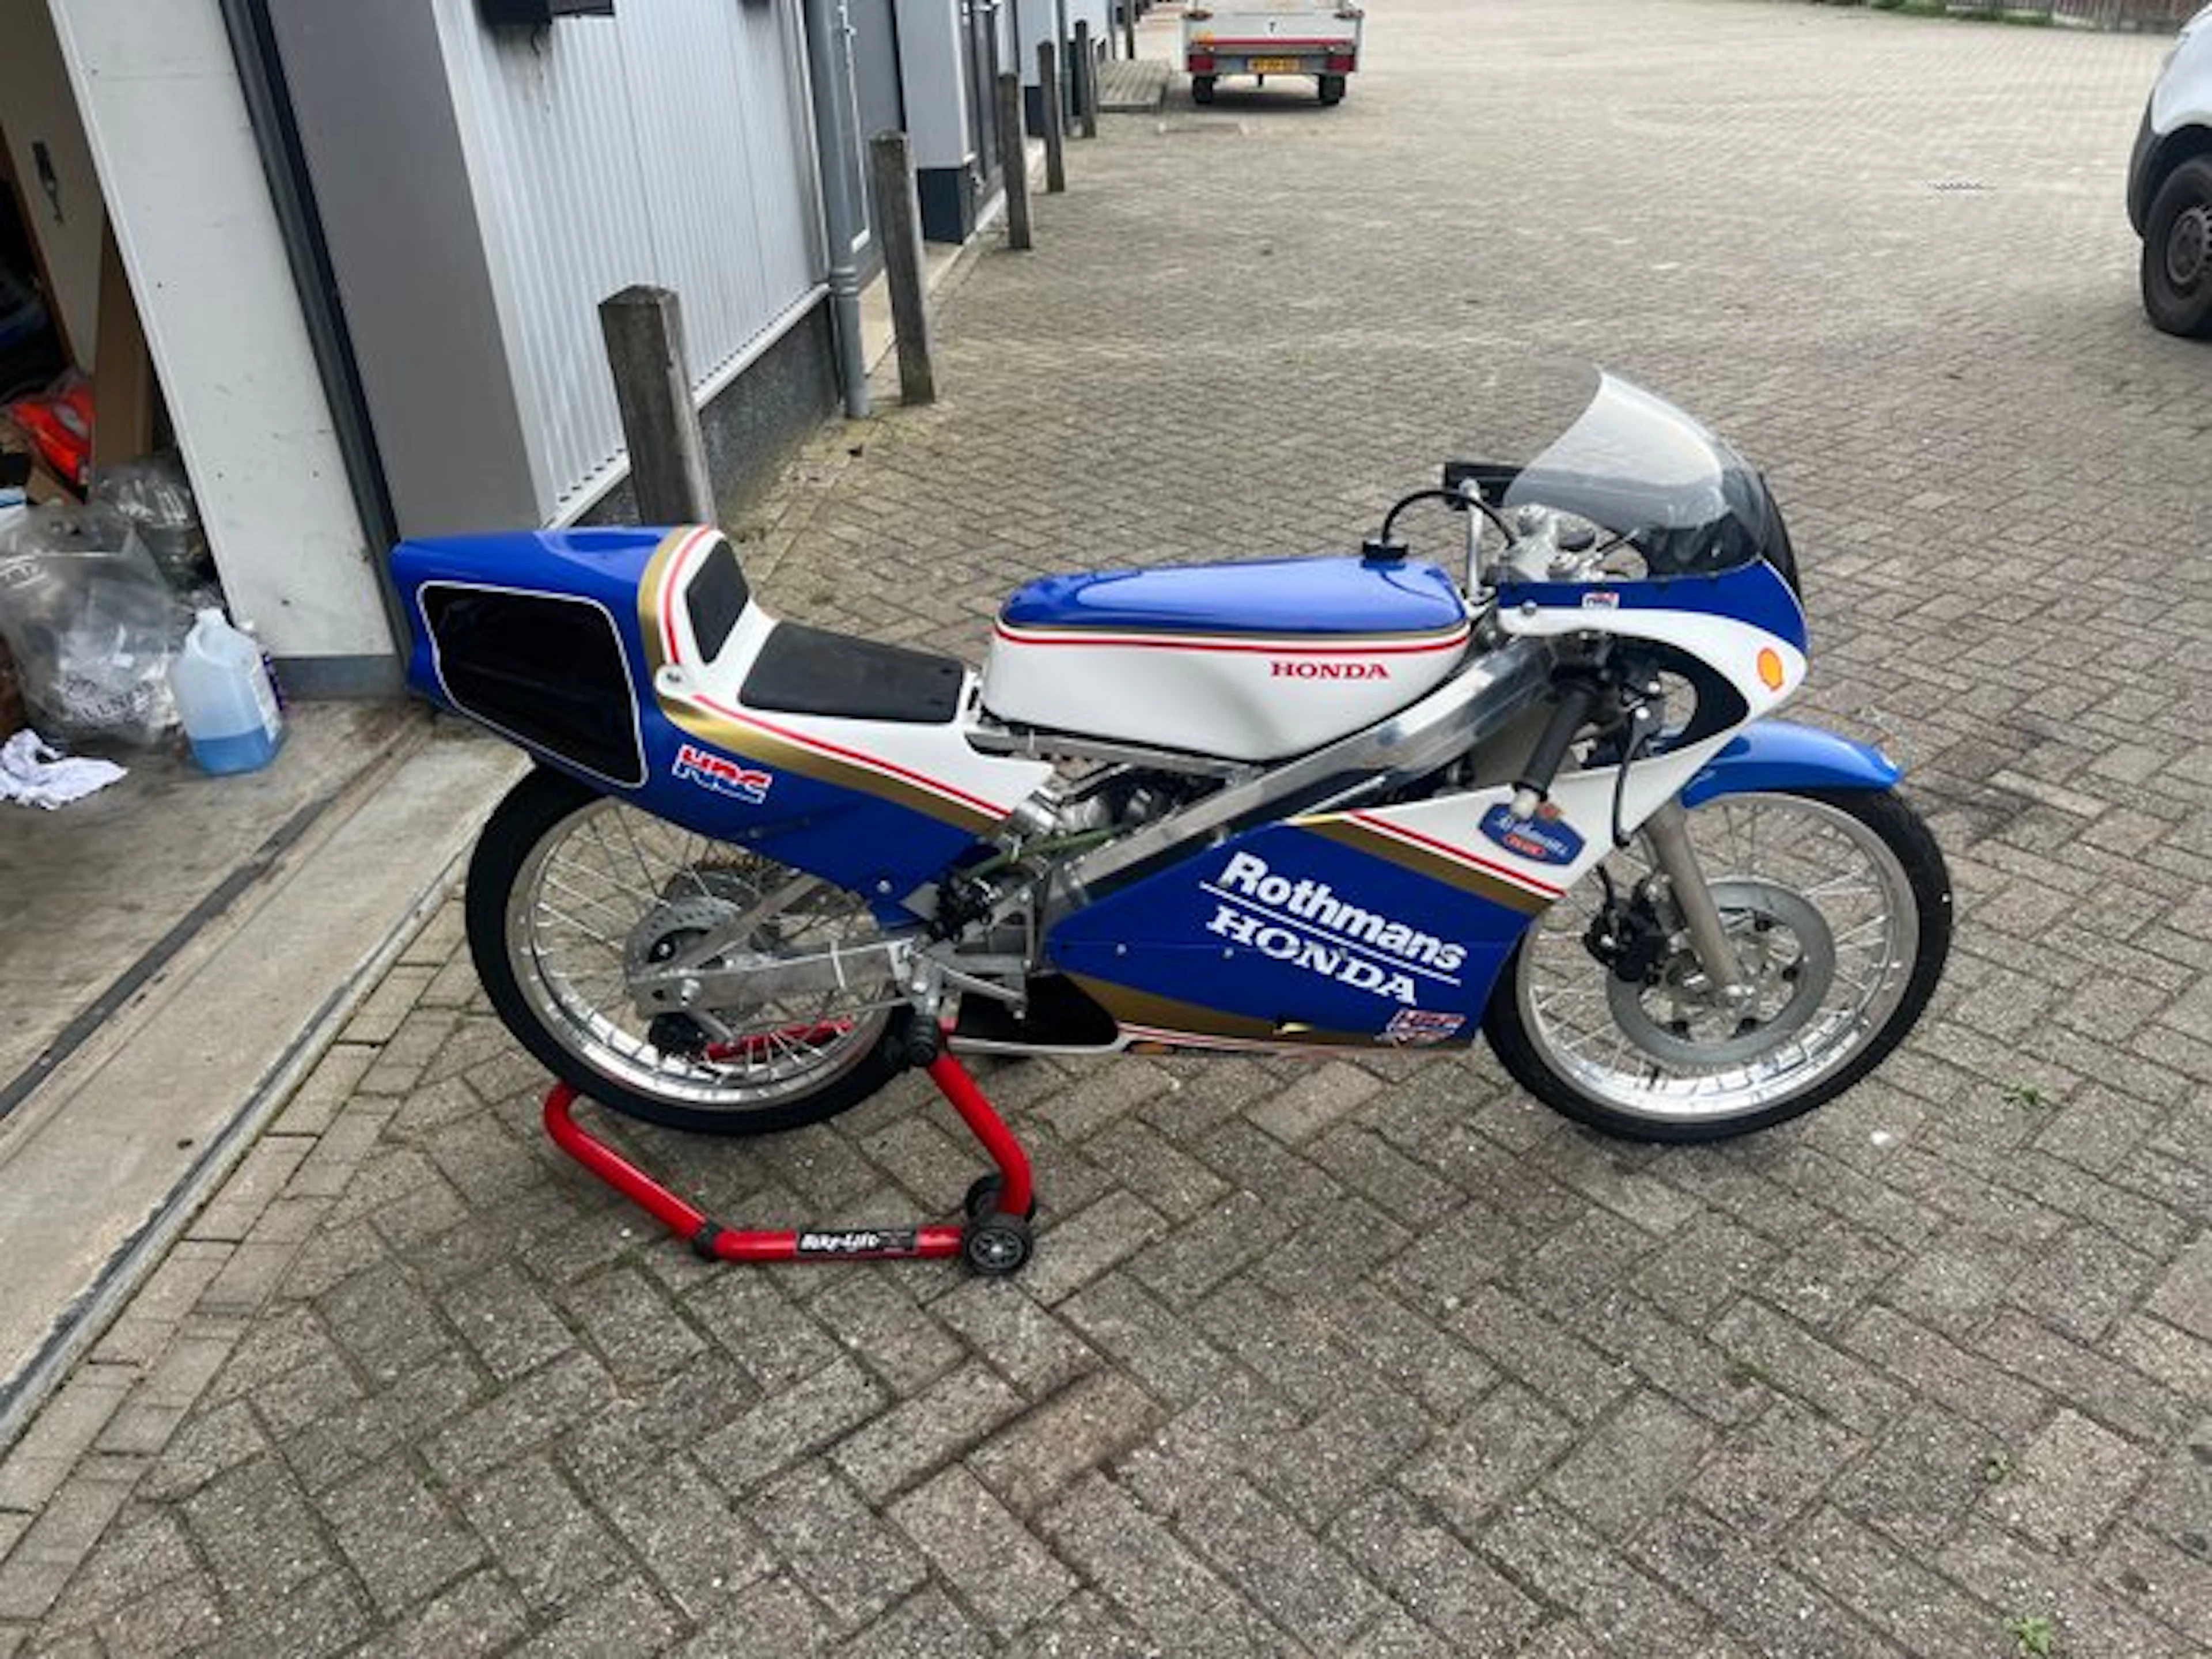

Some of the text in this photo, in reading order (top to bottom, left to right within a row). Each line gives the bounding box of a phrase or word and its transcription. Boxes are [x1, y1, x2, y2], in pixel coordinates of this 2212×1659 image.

[1270, 661, 1391, 679] HONDA
[672, 744, 772, 804] HRC
[1217, 851, 1468, 971] Rothmans
[1206, 905, 1418, 1006] HONDA
